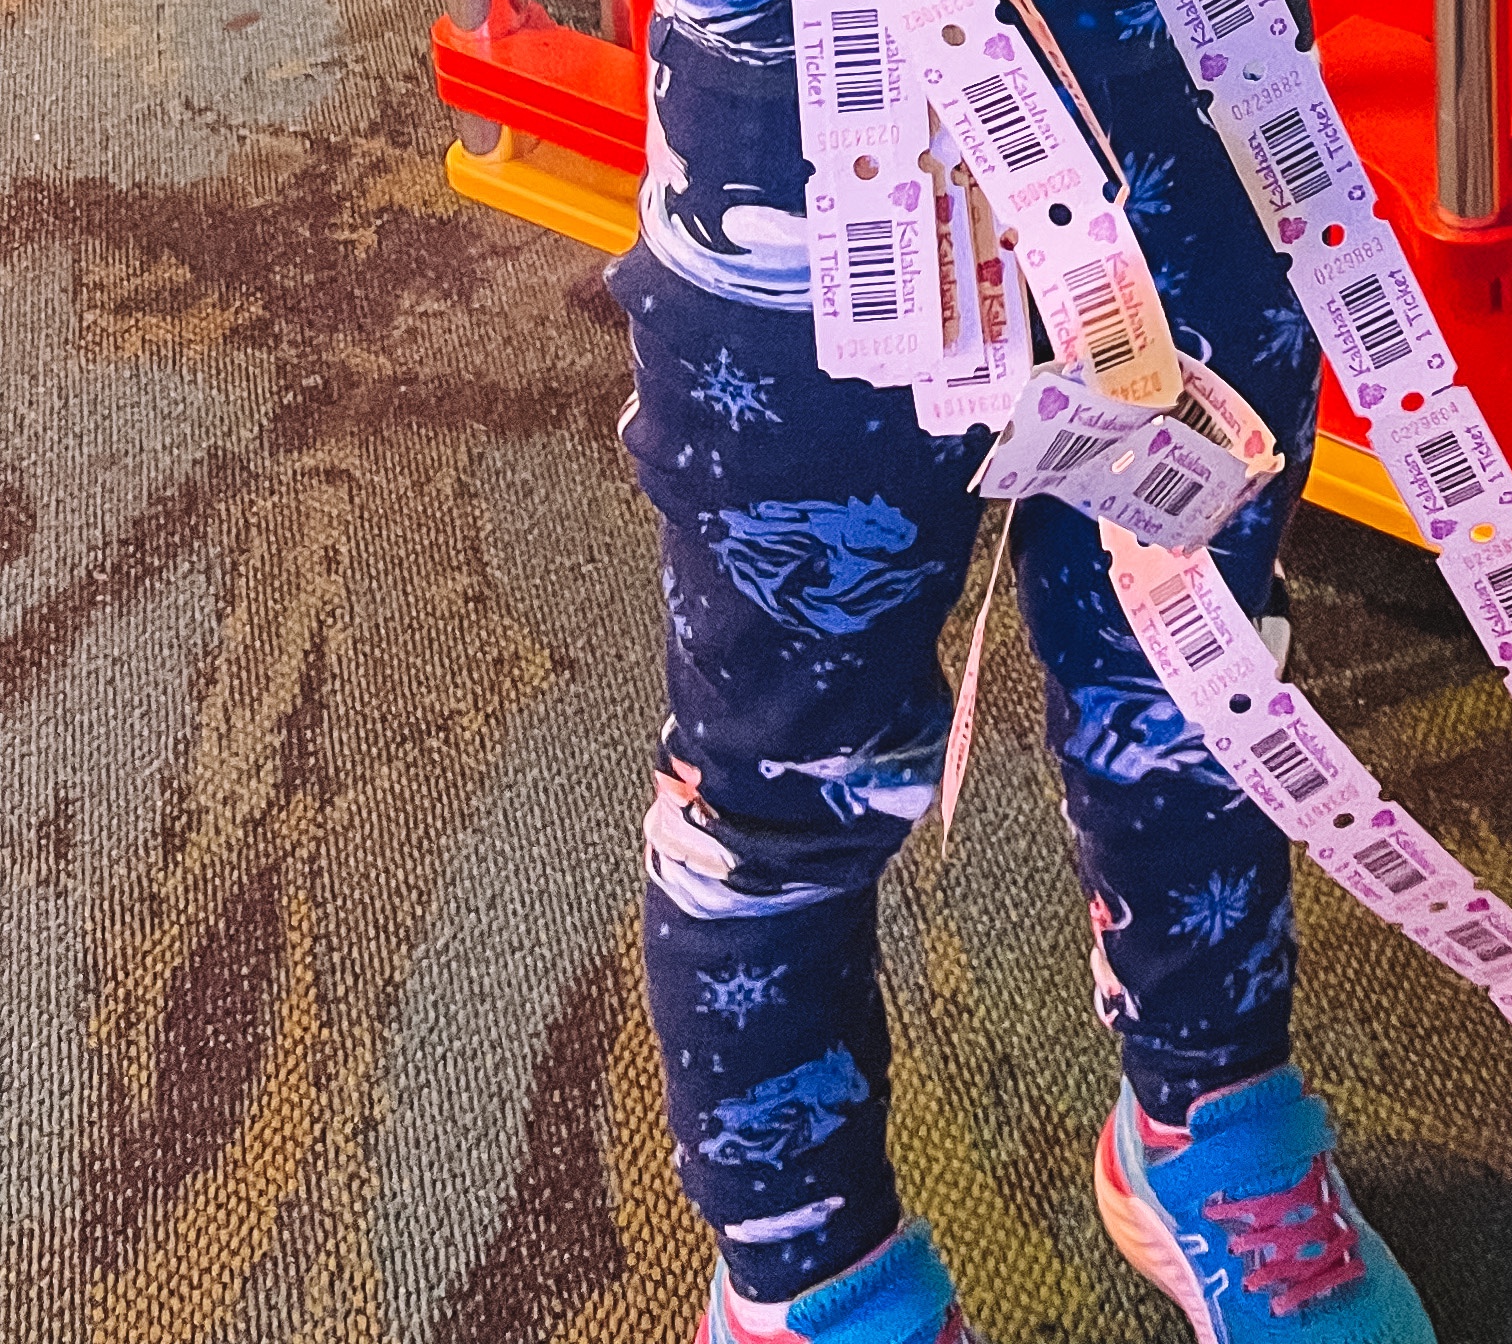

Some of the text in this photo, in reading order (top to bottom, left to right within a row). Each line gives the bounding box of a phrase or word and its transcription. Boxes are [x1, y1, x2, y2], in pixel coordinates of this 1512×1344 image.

[941, 96, 996, 176] 1 Ticket
[1003, 65, 1064, 154] Kalahari
[1231, 70, 1303, 122] 0229882
[1309, 100, 1353, 174] 1 Ticket
[1248, 129, 1291, 214] Kalahari
[815, 232, 841, 319] 1 Ticket
[895, 220, 923, 317] Kalahari
[1105, 250, 1151, 355] Kalahari
[1388, 267, 1432, 342] 1 Ticket
[1324, 296, 1372, 378] Kalahari
